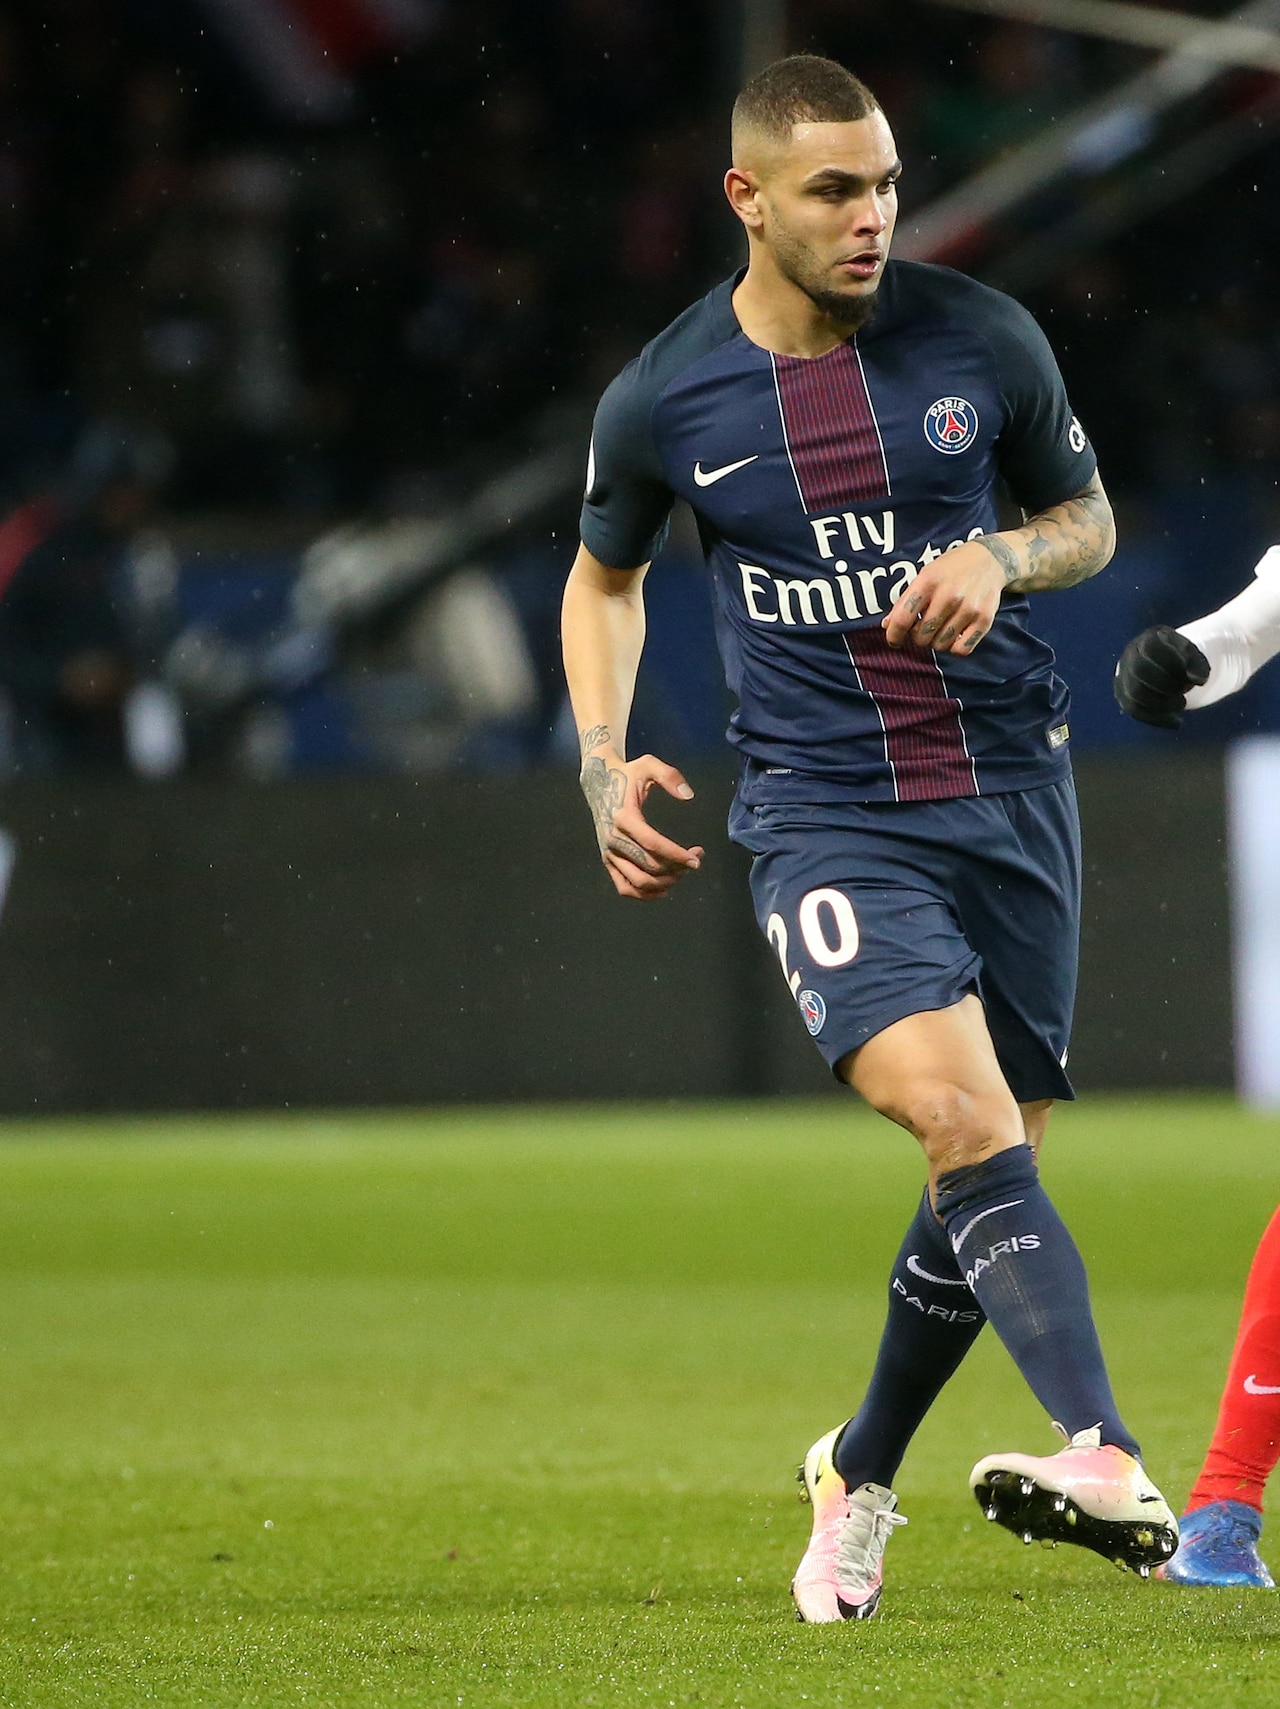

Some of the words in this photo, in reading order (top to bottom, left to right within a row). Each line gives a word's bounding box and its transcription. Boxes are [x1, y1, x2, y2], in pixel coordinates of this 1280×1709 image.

[930, 400, 966, 417] PARIS
[810, 510, 894, 559] Fly
[738, 527, 985, 625] Emira
[766, 887, 860, 1002] 20
[966, 1234, 1041, 1294] PARIS
[892, 1277, 980, 1323] PARIS
